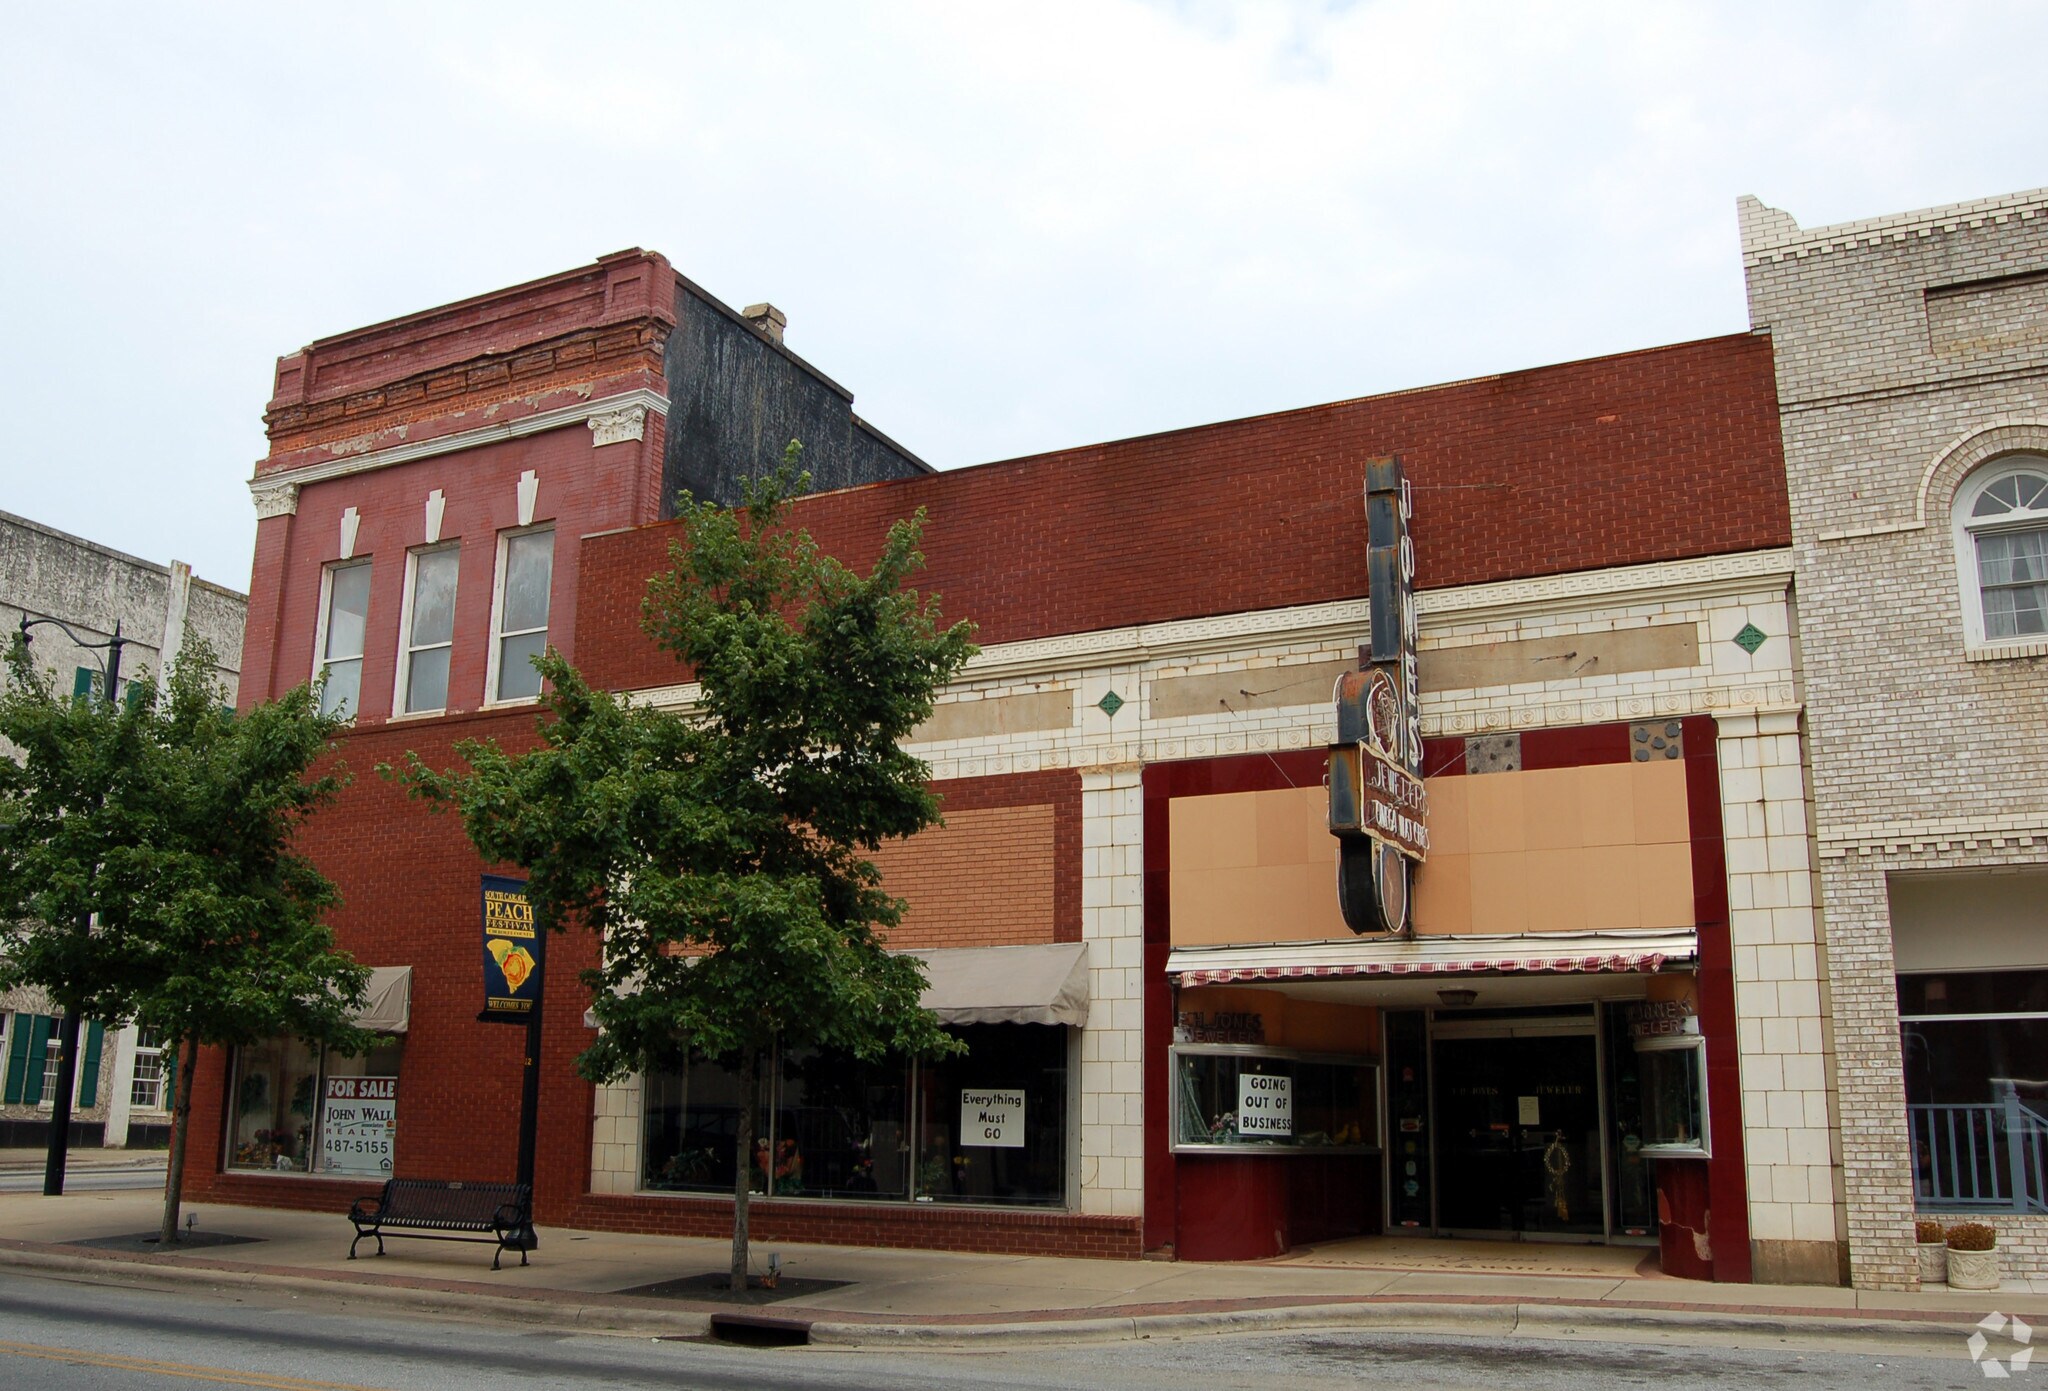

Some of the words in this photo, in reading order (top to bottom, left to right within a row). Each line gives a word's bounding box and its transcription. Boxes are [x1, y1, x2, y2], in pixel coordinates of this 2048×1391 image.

[485, 890, 504, 901] SOUTH
[485, 900, 533, 921] PEACH
[488, 1000, 519, 1009] WELCOMES
[328, 1080, 356, 1097] FOR
[359, 1080, 395, 1097] SALE
[1251, 1077, 1286, 1091] GOING
[963, 1093, 1021, 1108] Everything
[1245, 1096, 1269, 1108] OUT
[1275, 1097, 1287, 1109] OF
[325, 1106, 356, 1123] JOHN
[361, 1107, 393, 1121] WALL
[979, 1111, 1005, 1123] Must
[1243, 1116, 1291, 1130] BUSINESS
[325, 1128, 379, 1136] REALT
[984, 1127, 1001, 1140] GO
[325, 1139, 388, 1154] 487-5155
